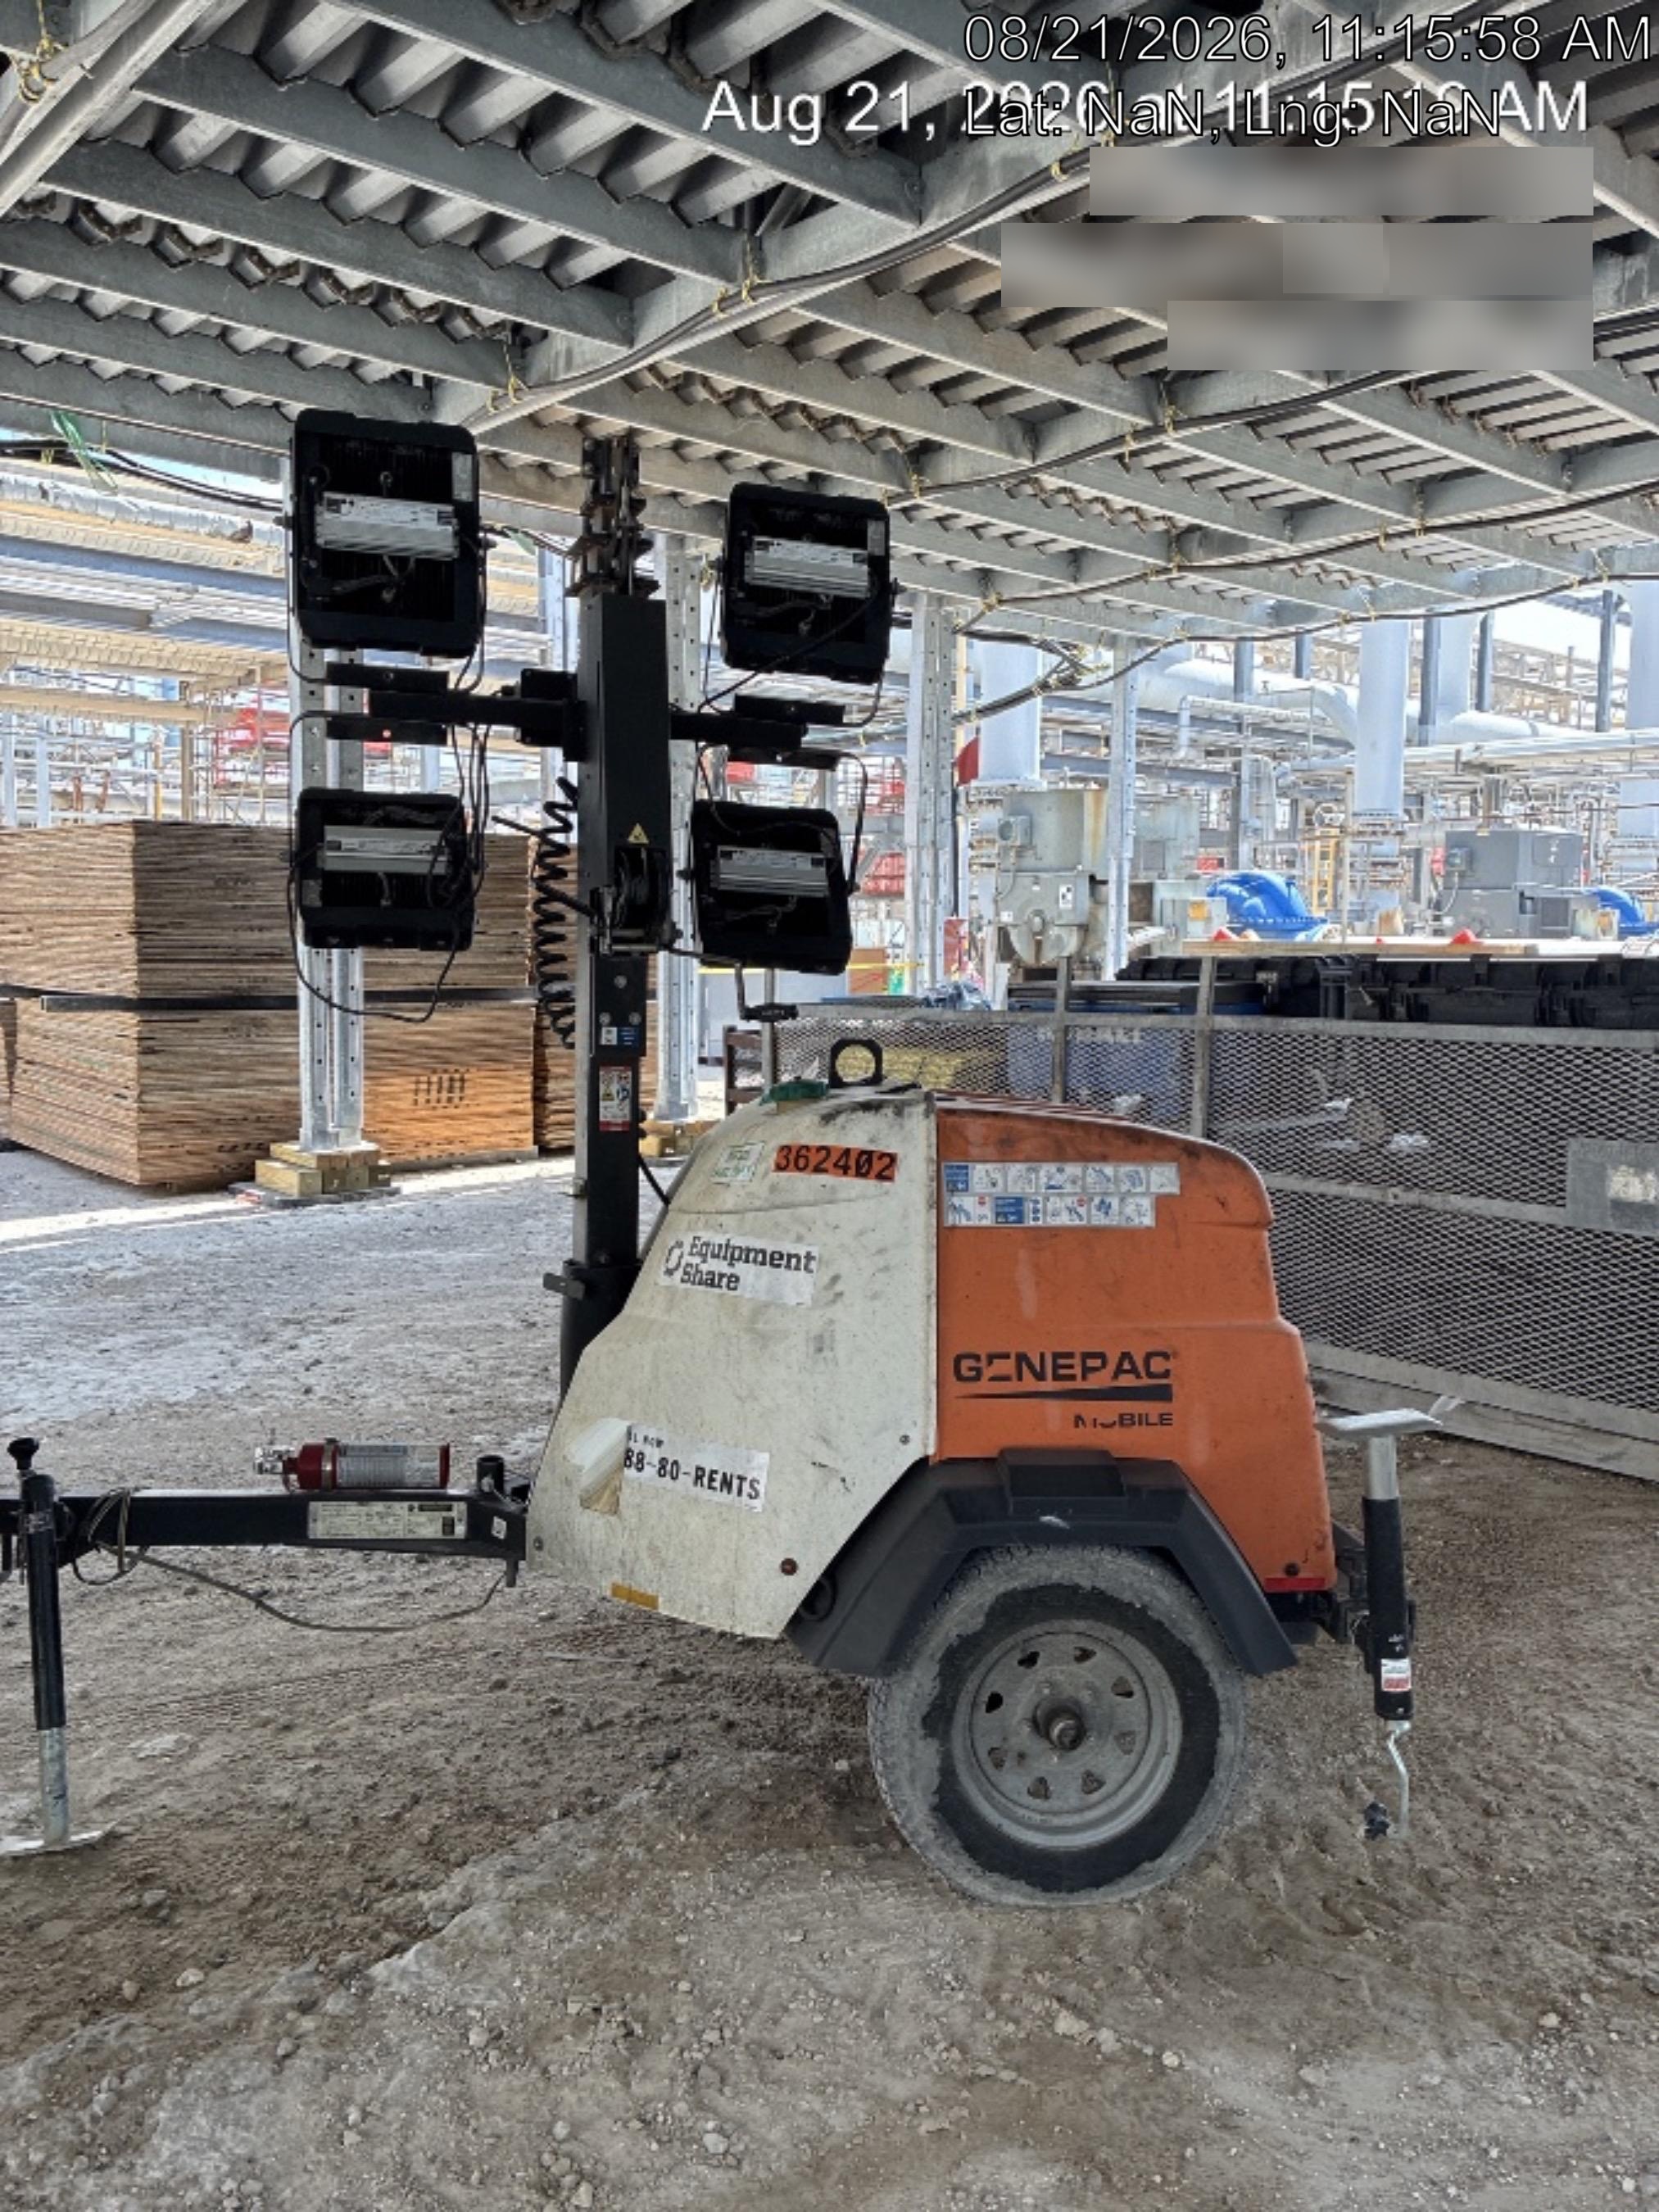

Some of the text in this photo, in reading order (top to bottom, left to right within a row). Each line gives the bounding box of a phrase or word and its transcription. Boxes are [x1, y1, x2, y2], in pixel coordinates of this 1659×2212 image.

[775, 1145, 897, 1182] 362402
[688, 1235, 817, 1274] Equipment
[680, 1262, 741, 1292] Share
